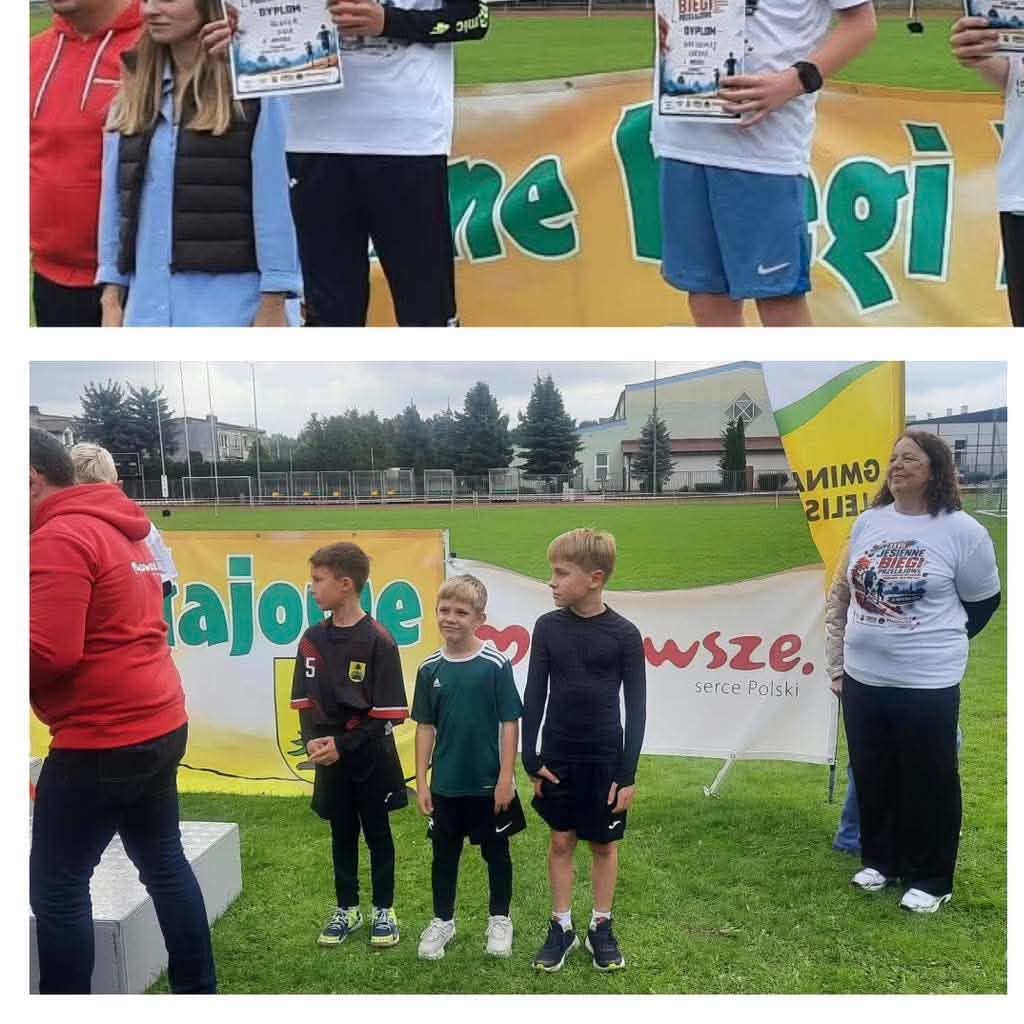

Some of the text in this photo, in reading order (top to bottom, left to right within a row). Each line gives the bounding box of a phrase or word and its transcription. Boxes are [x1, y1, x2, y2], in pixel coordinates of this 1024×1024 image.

[259, 4, 302, 17] DYPLOM
[683, 26, 716, 36] DYPLOM
[876, 549, 926, 557] JESIENNE
[877, 557, 925, 569] BIEGI
[305, 657, 316, 678] 5
[695, 679, 800, 697] serce Polski
